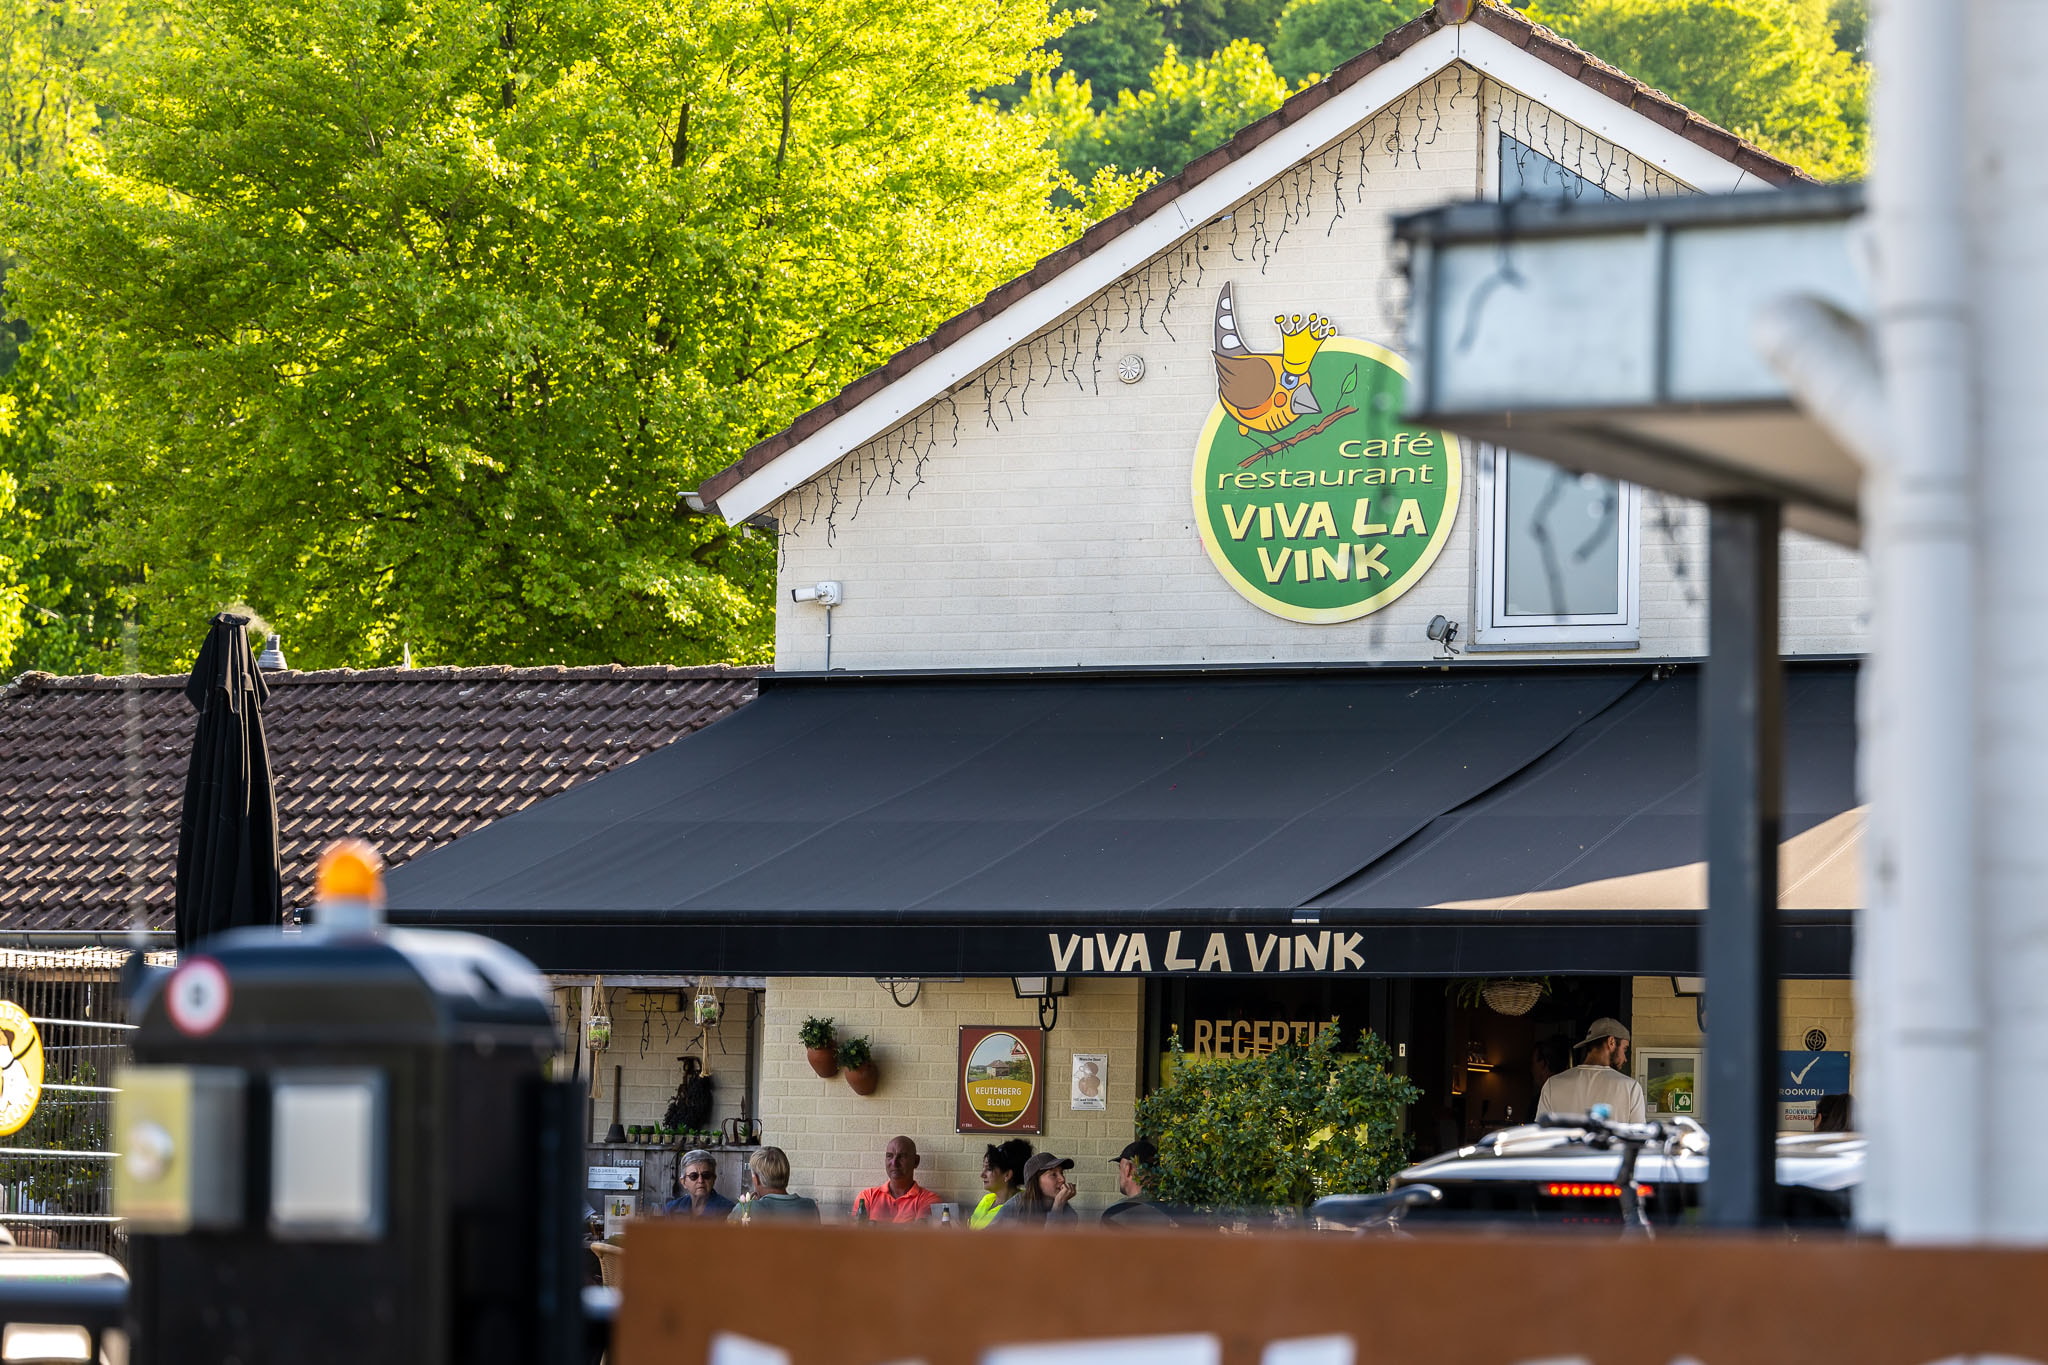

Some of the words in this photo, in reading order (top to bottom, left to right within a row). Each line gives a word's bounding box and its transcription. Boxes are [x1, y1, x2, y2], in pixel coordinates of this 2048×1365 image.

[1338, 432, 1434, 459] café
[1218, 463, 1434, 490] restaurant
[1221, 501, 1341, 541] VIVA
[1351, 498, 1428, 538] LA
[1256, 542, 1392, 585] VINK
[1048, 932, 1152, 972] VIVA
[1163, 930, 1232, 972] LA
[1245, 930, 1366, 972] VINK
[975, 1086, 1022, 1096] KEUTENBERG
[986, 1097, 1012, 1107] BLOND
[1779, 1088, 1825, 1096] ROOKVRIJ
